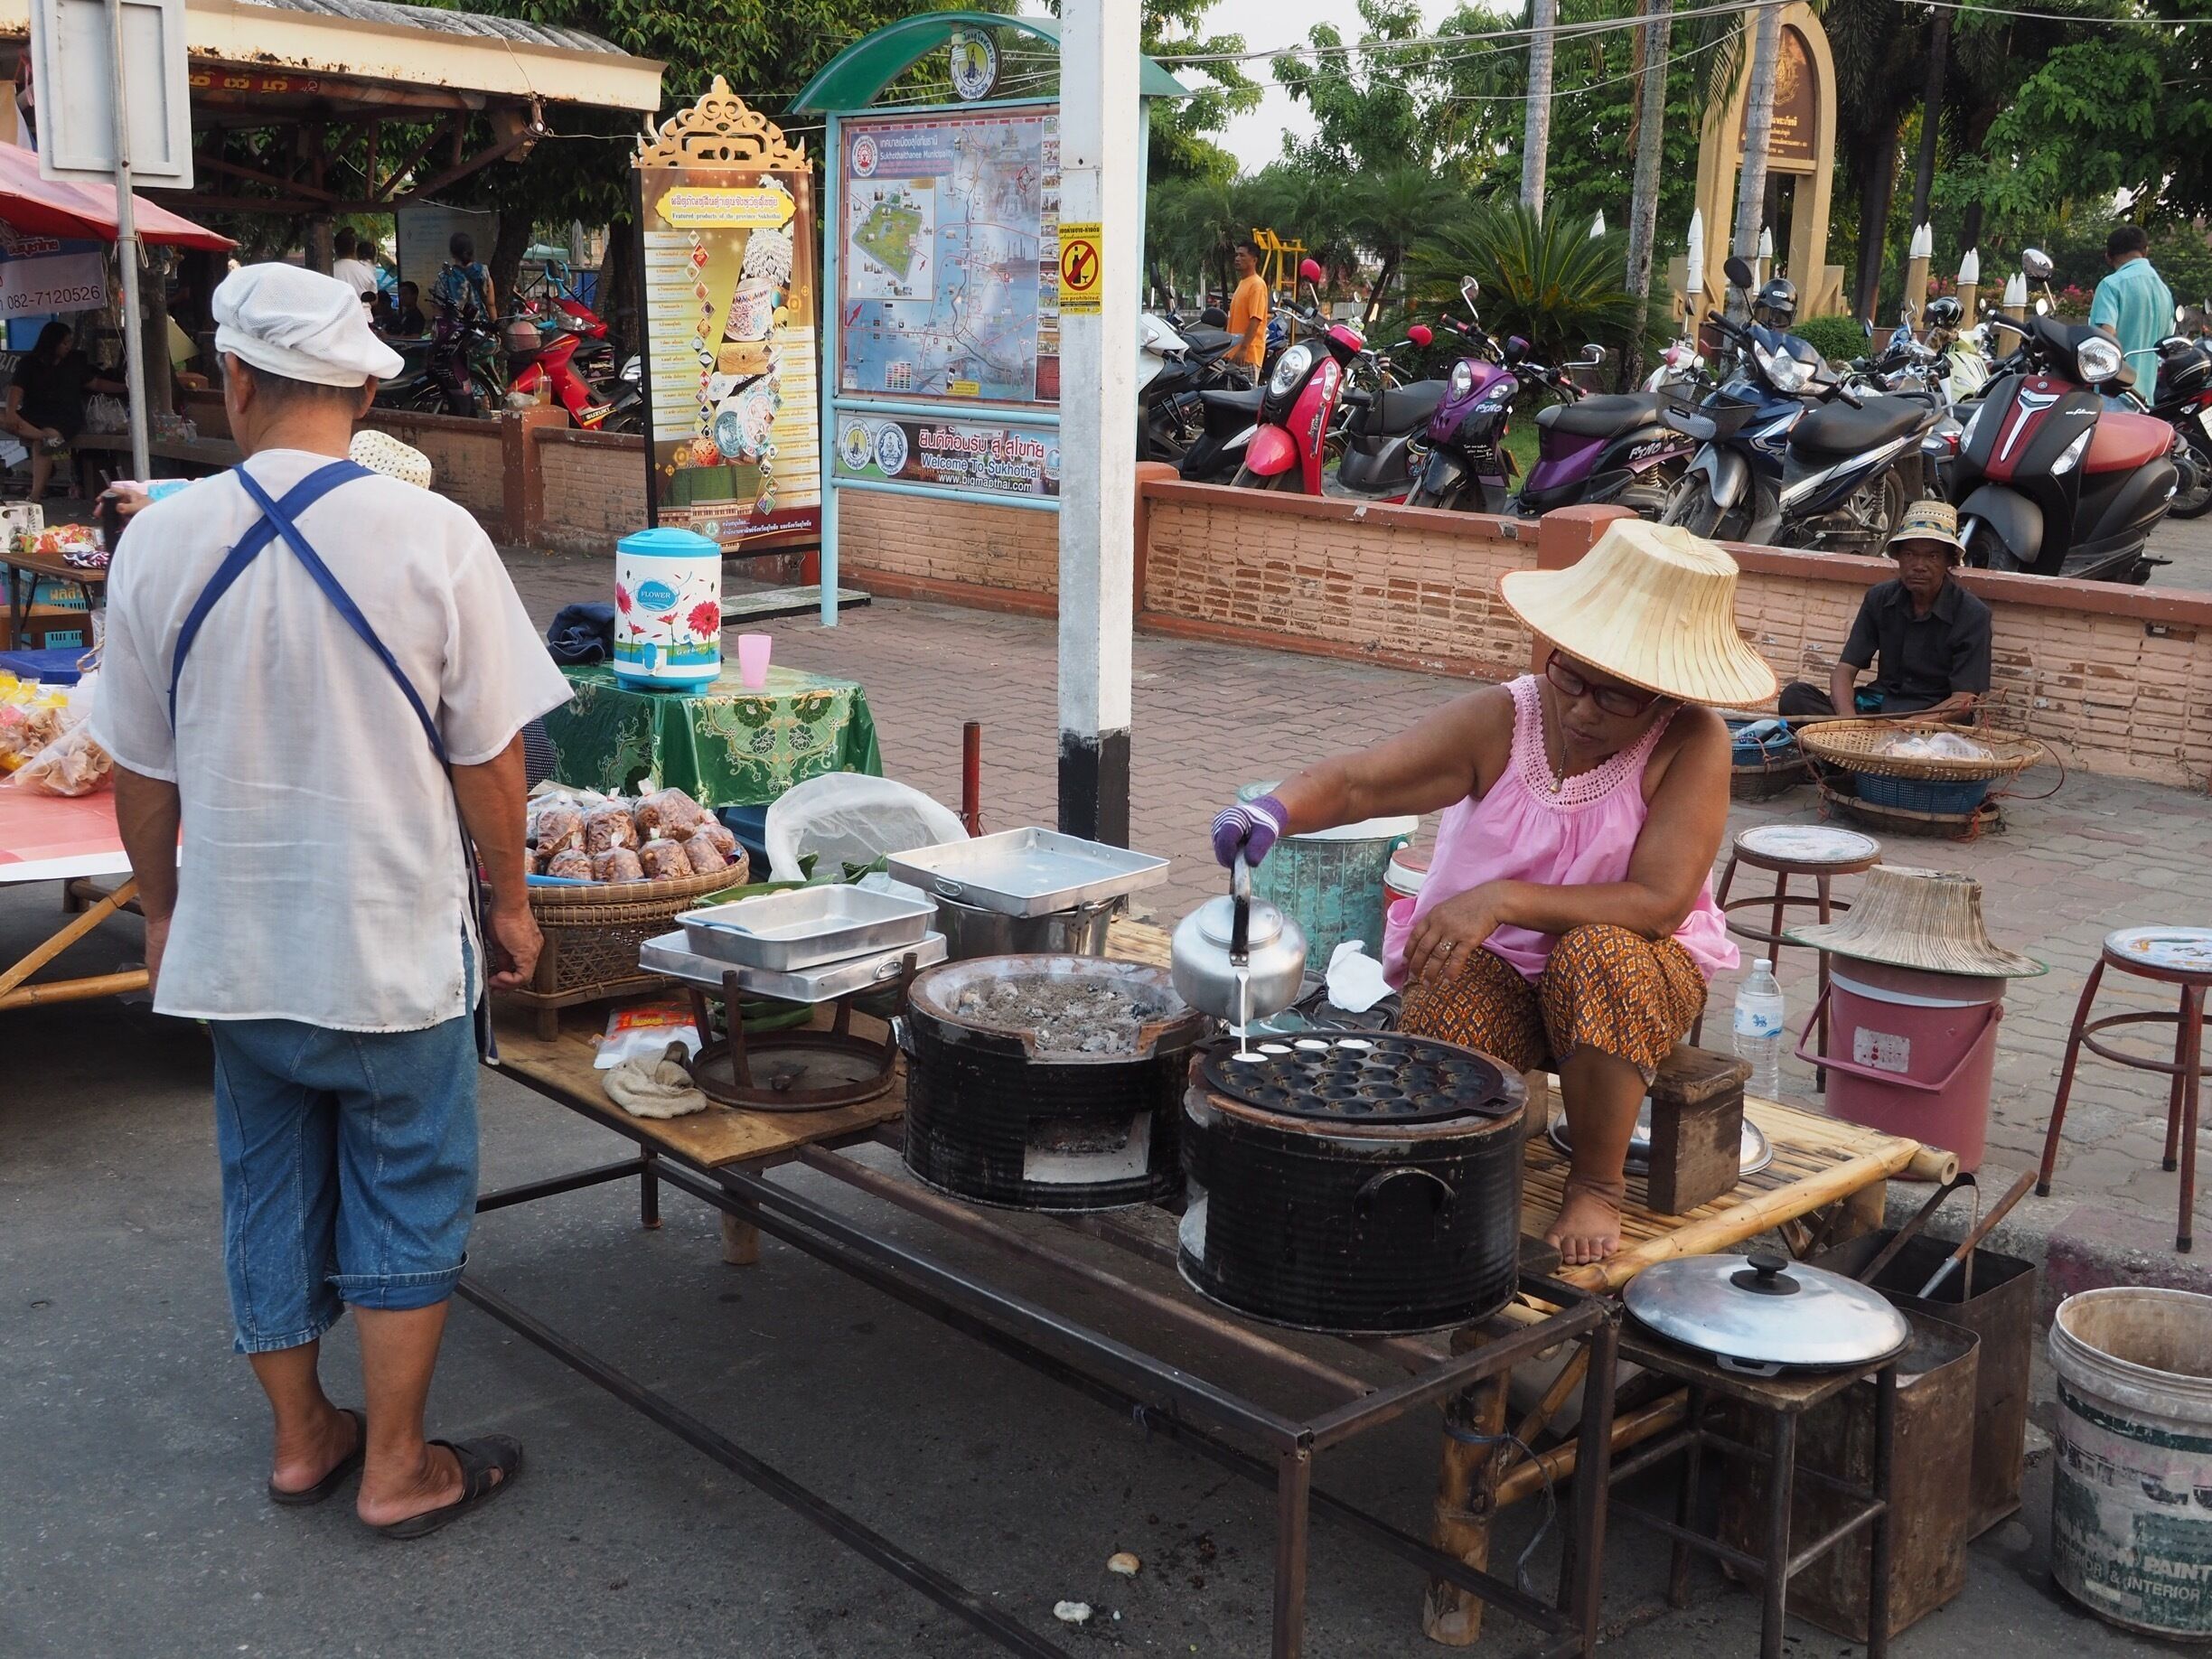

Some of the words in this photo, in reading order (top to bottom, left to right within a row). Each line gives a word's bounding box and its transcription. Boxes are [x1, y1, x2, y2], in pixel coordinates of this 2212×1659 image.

[880, 151, 922, 160] Sukhothaithanee
[923, 150, 954, 160] Municipality
[696, 212, 717, 220] products
[7, 286, 100, 310] 082-7120526
[586, 407, 611, 419] SUZUKI
[1476, 404, 1503, 413] FINO
[919, 426, 987, 452] ยินดีต้อนรับ
[991, 432, 1001, 459] สู่
[1005, 435, 1045, 462] สุโขทัย
[1628, 442, 1662, 460] FINO
[921, 453, 969, 471] Welcome
[971, 459, 985, 472] To
[988, 461, 1041, 480] Sukhothai
[938, 472, 1033, 493] www.bigmapthai.com
[641, 591, 671, 599] FLOWER
[2143, 1554, 2212, 1581] PAINT
[2126, 1575, 2201, 1601] INTERIOR
